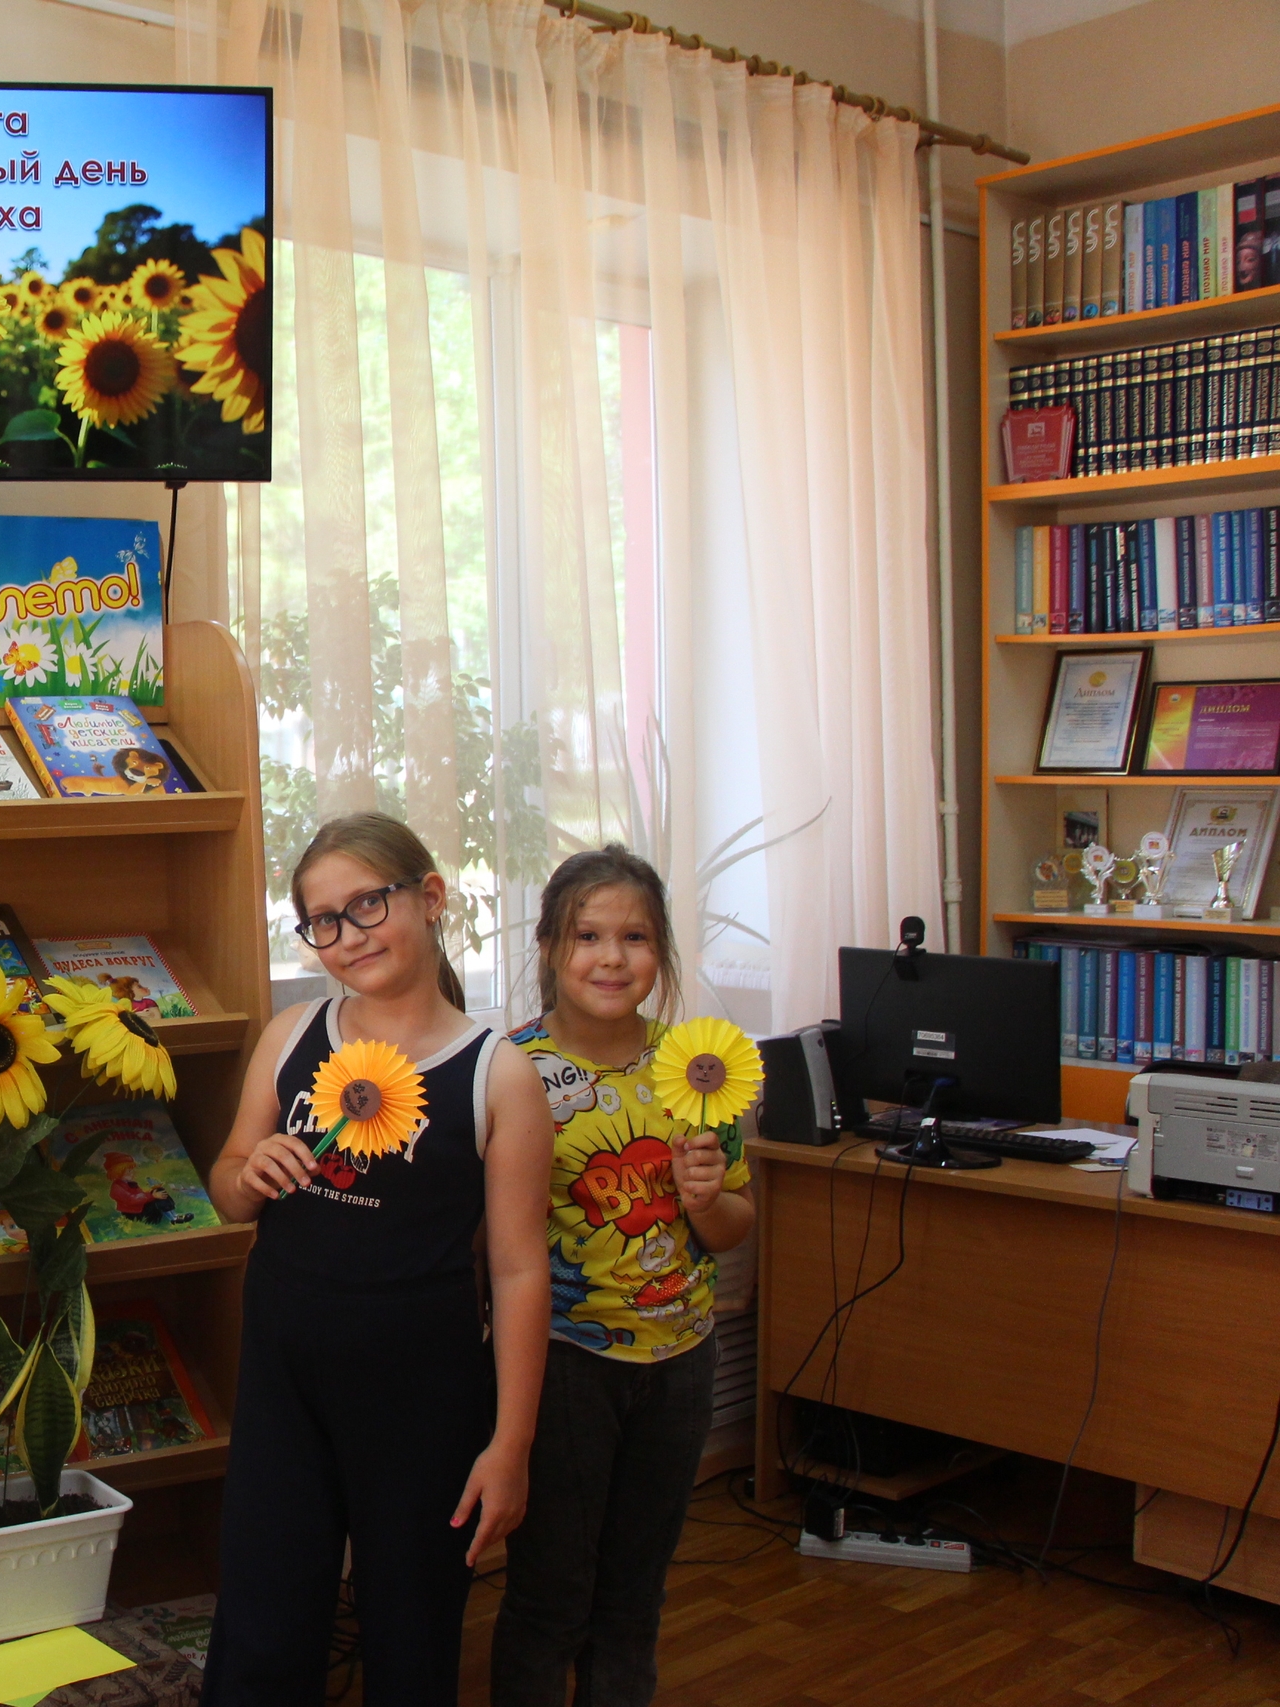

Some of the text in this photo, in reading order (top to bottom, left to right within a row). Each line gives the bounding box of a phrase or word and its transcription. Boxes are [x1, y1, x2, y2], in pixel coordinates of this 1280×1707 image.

[54, 157, 147, 186] день
[1202, 258, 1210, 293] ПОЗНАЮ
[58, 717, 125, 729] Любимые
[68, 728, 127, 739] детские
[71, 737, 136, 747] писатели
[1189, 828, 1248, 837] ДИПЛОМ
[53, 955, 156, 973] ЧУДЕСА ВОКРУГ
[541, 1066, 589, 1092] NG!!
[104, 1131, 154, 1141] ЯНКА
[324, 1188, 340, 1200] THE
[341, 1193, 380, 1208] STORIES
[90, 1354, 161, 1382] казки
